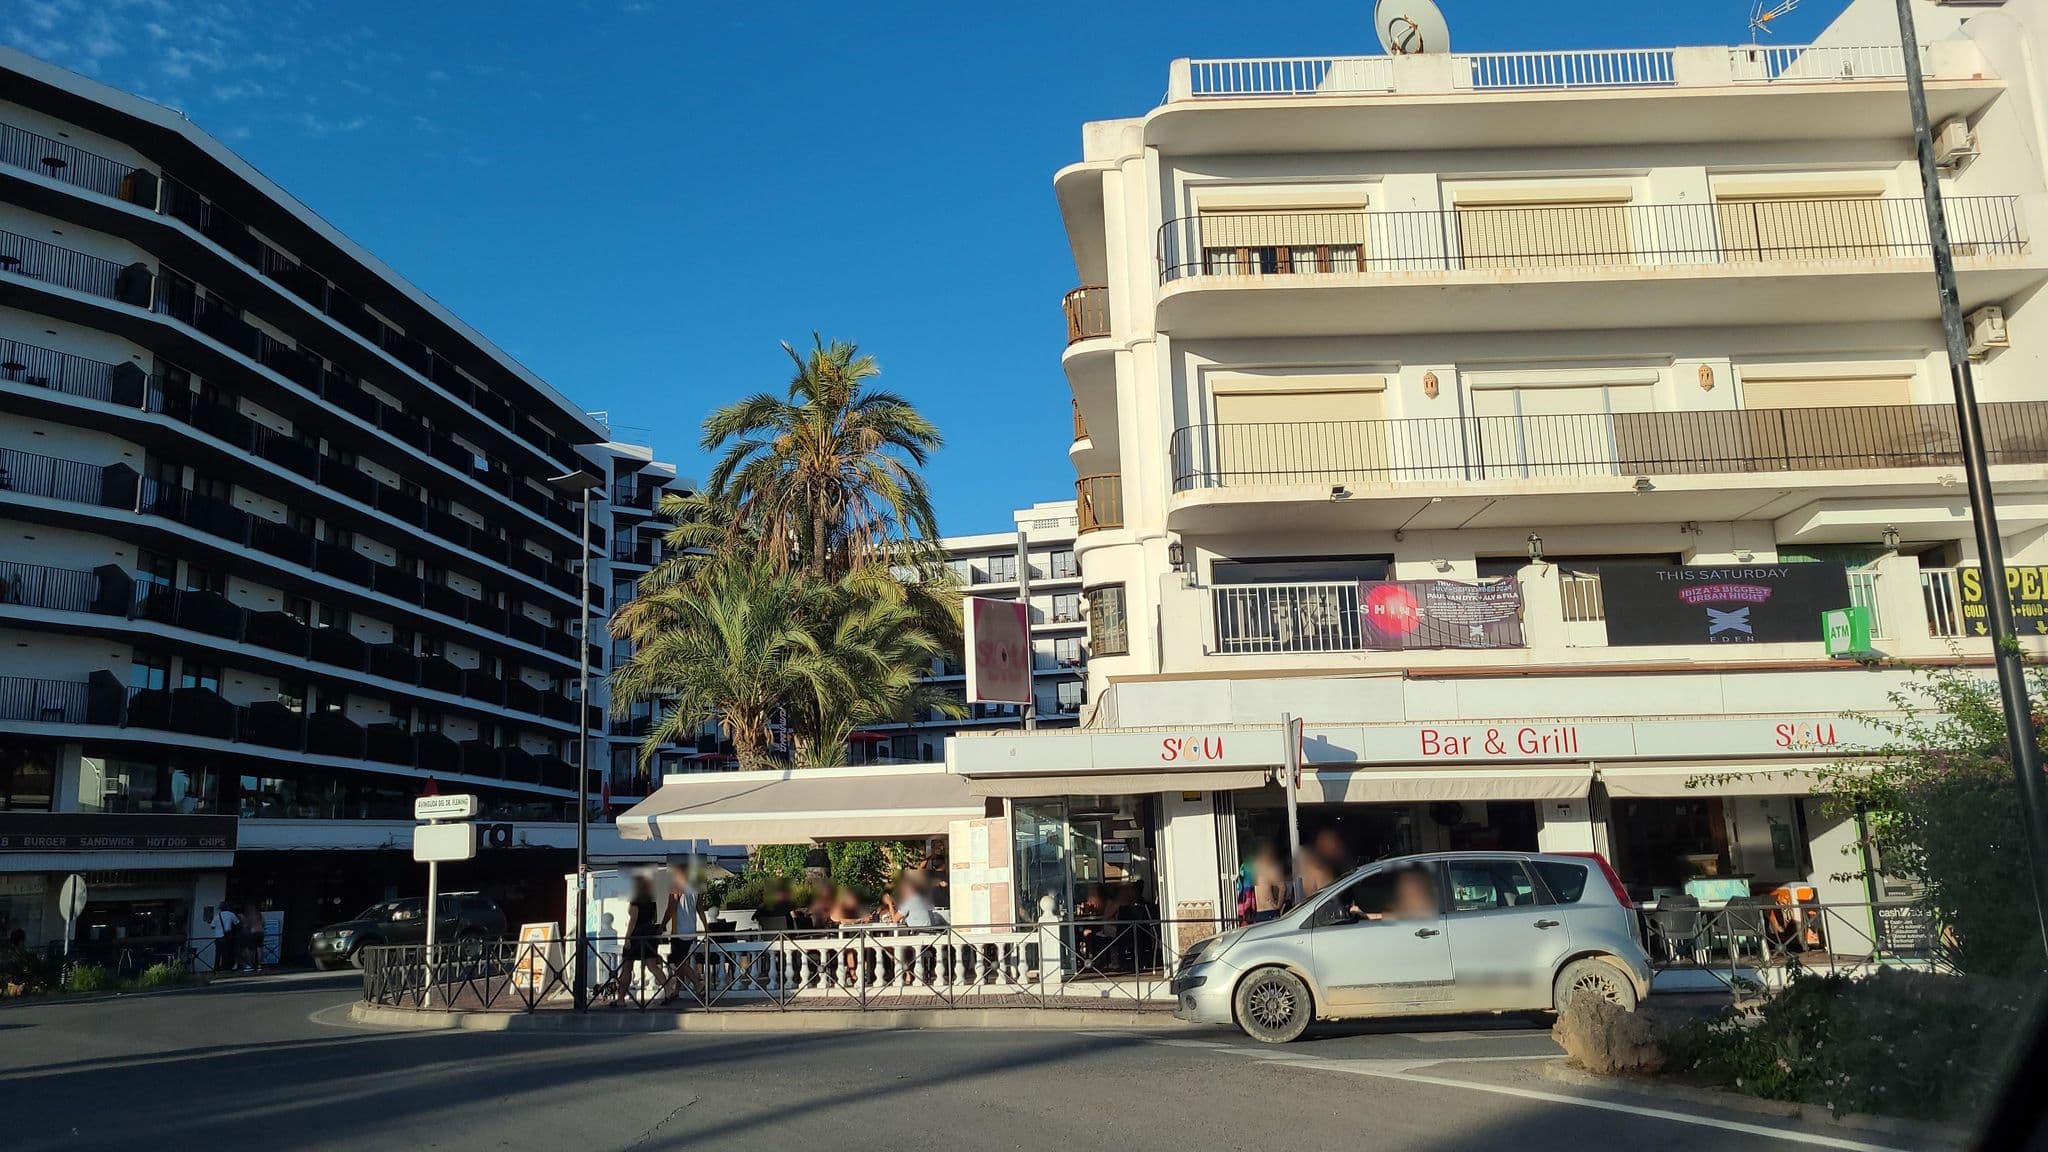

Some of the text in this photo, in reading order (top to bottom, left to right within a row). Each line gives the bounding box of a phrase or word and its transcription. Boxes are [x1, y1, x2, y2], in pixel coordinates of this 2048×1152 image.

[1656, 568, 1788, 581] THIS SATURDAY
[1962, 567, 2048, 601] SPE
[1681, 586, 1768, 598] IBIZA'S BIGGEST
[1688, 592, 1763, 603] URBAN NIGHT
[1964, 605, 1985, 618] COLD
[2021, 604, 2043, 616] FOOD
[1831, 625, 1849, 639] ATM
[1421, 727, 1578, 755] Bar & Grill
[24, 836, 66, 847] BURGER
[80, 836, 134, 847] SANDWICH
[147, 837, 167, 847] HOT
[168, 837, 188, 847] DOG
[199, 836, 226, 846] CHIPS
